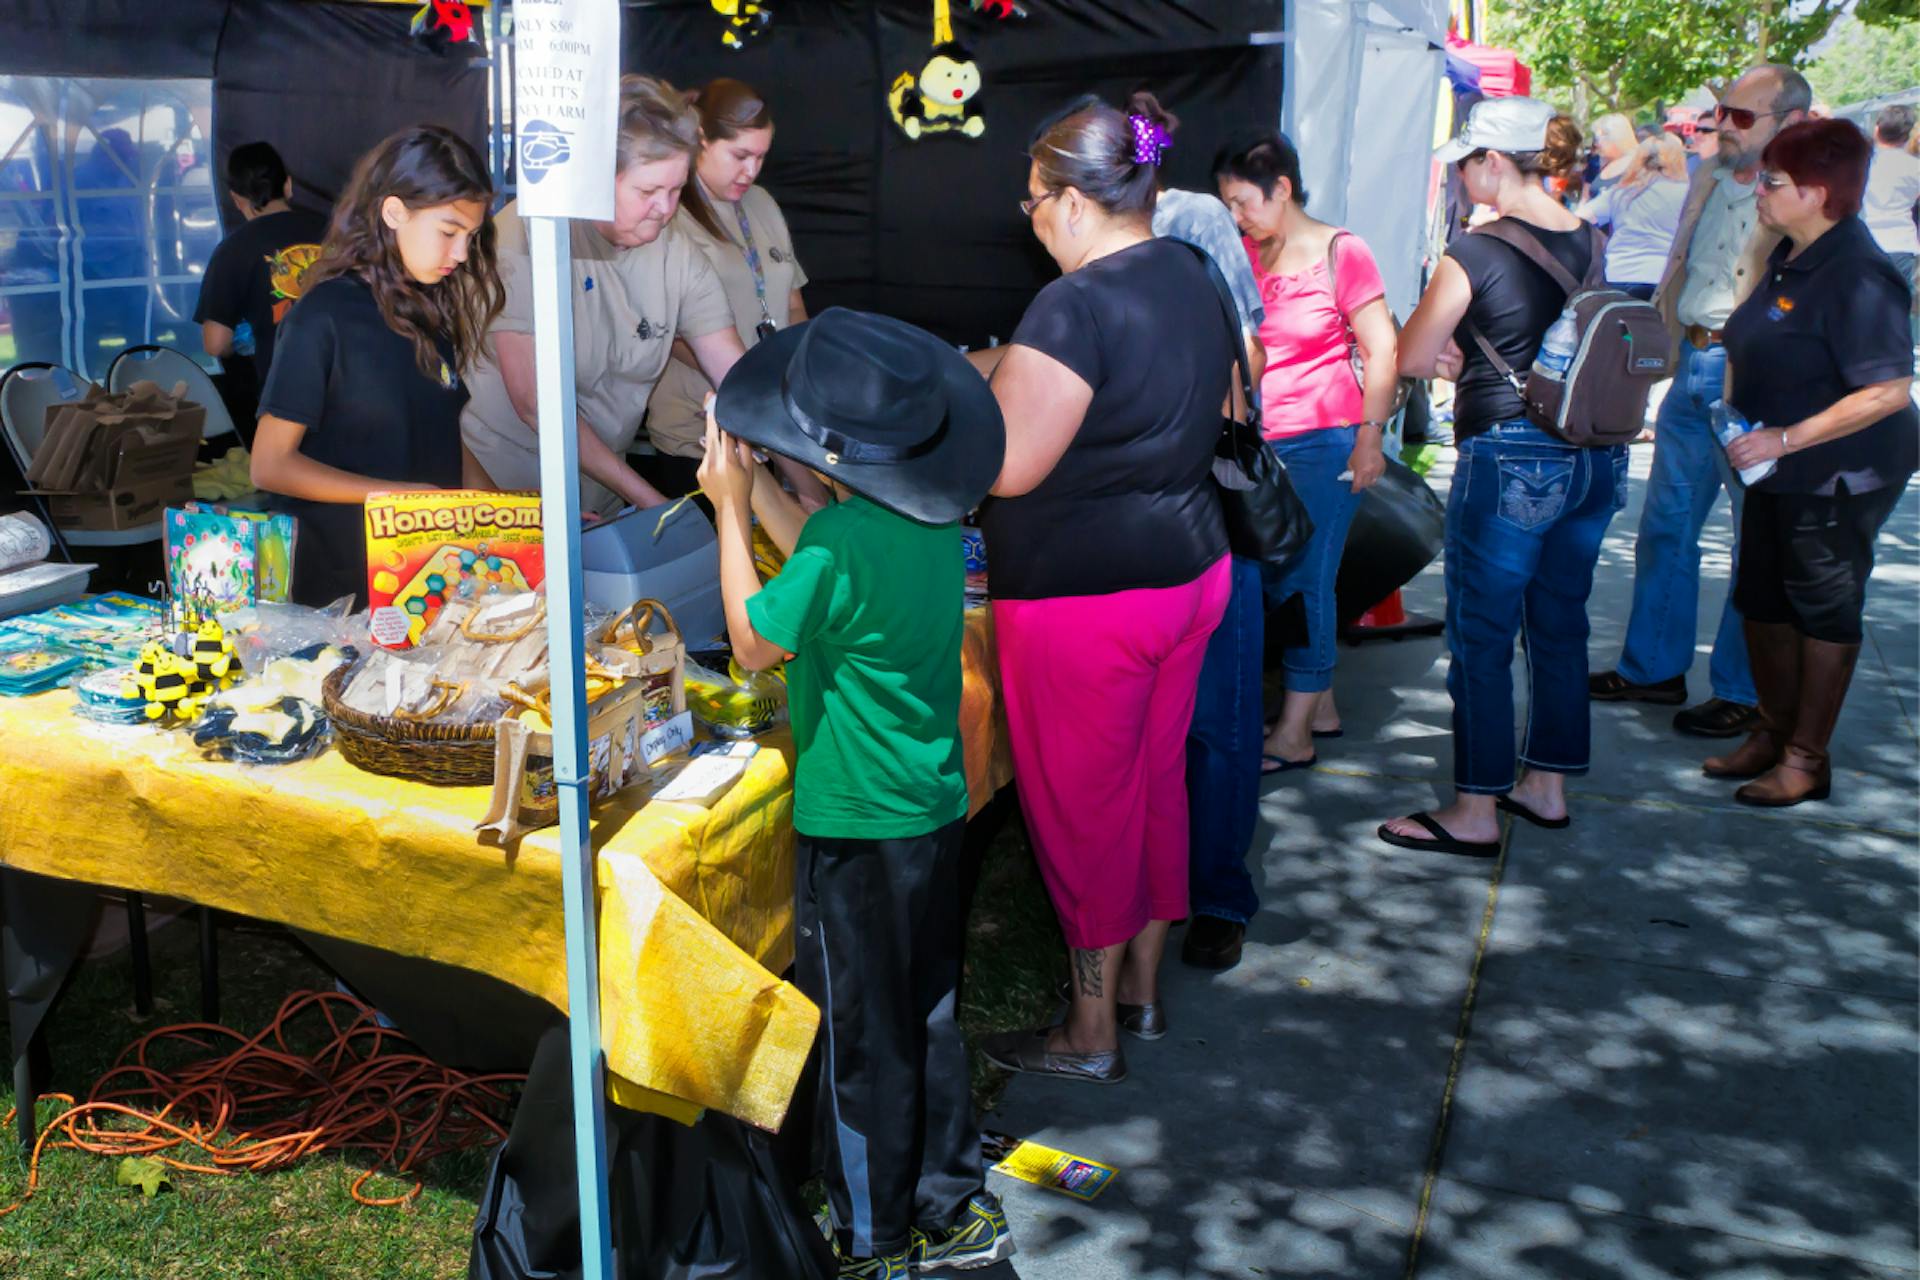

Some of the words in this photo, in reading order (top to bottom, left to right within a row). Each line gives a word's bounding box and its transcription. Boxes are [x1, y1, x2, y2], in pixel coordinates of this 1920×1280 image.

[565, 68, 584, 82] AT
[546, 105, 586, 120] FARM
[368, 503, 543, 540] Honeycom
